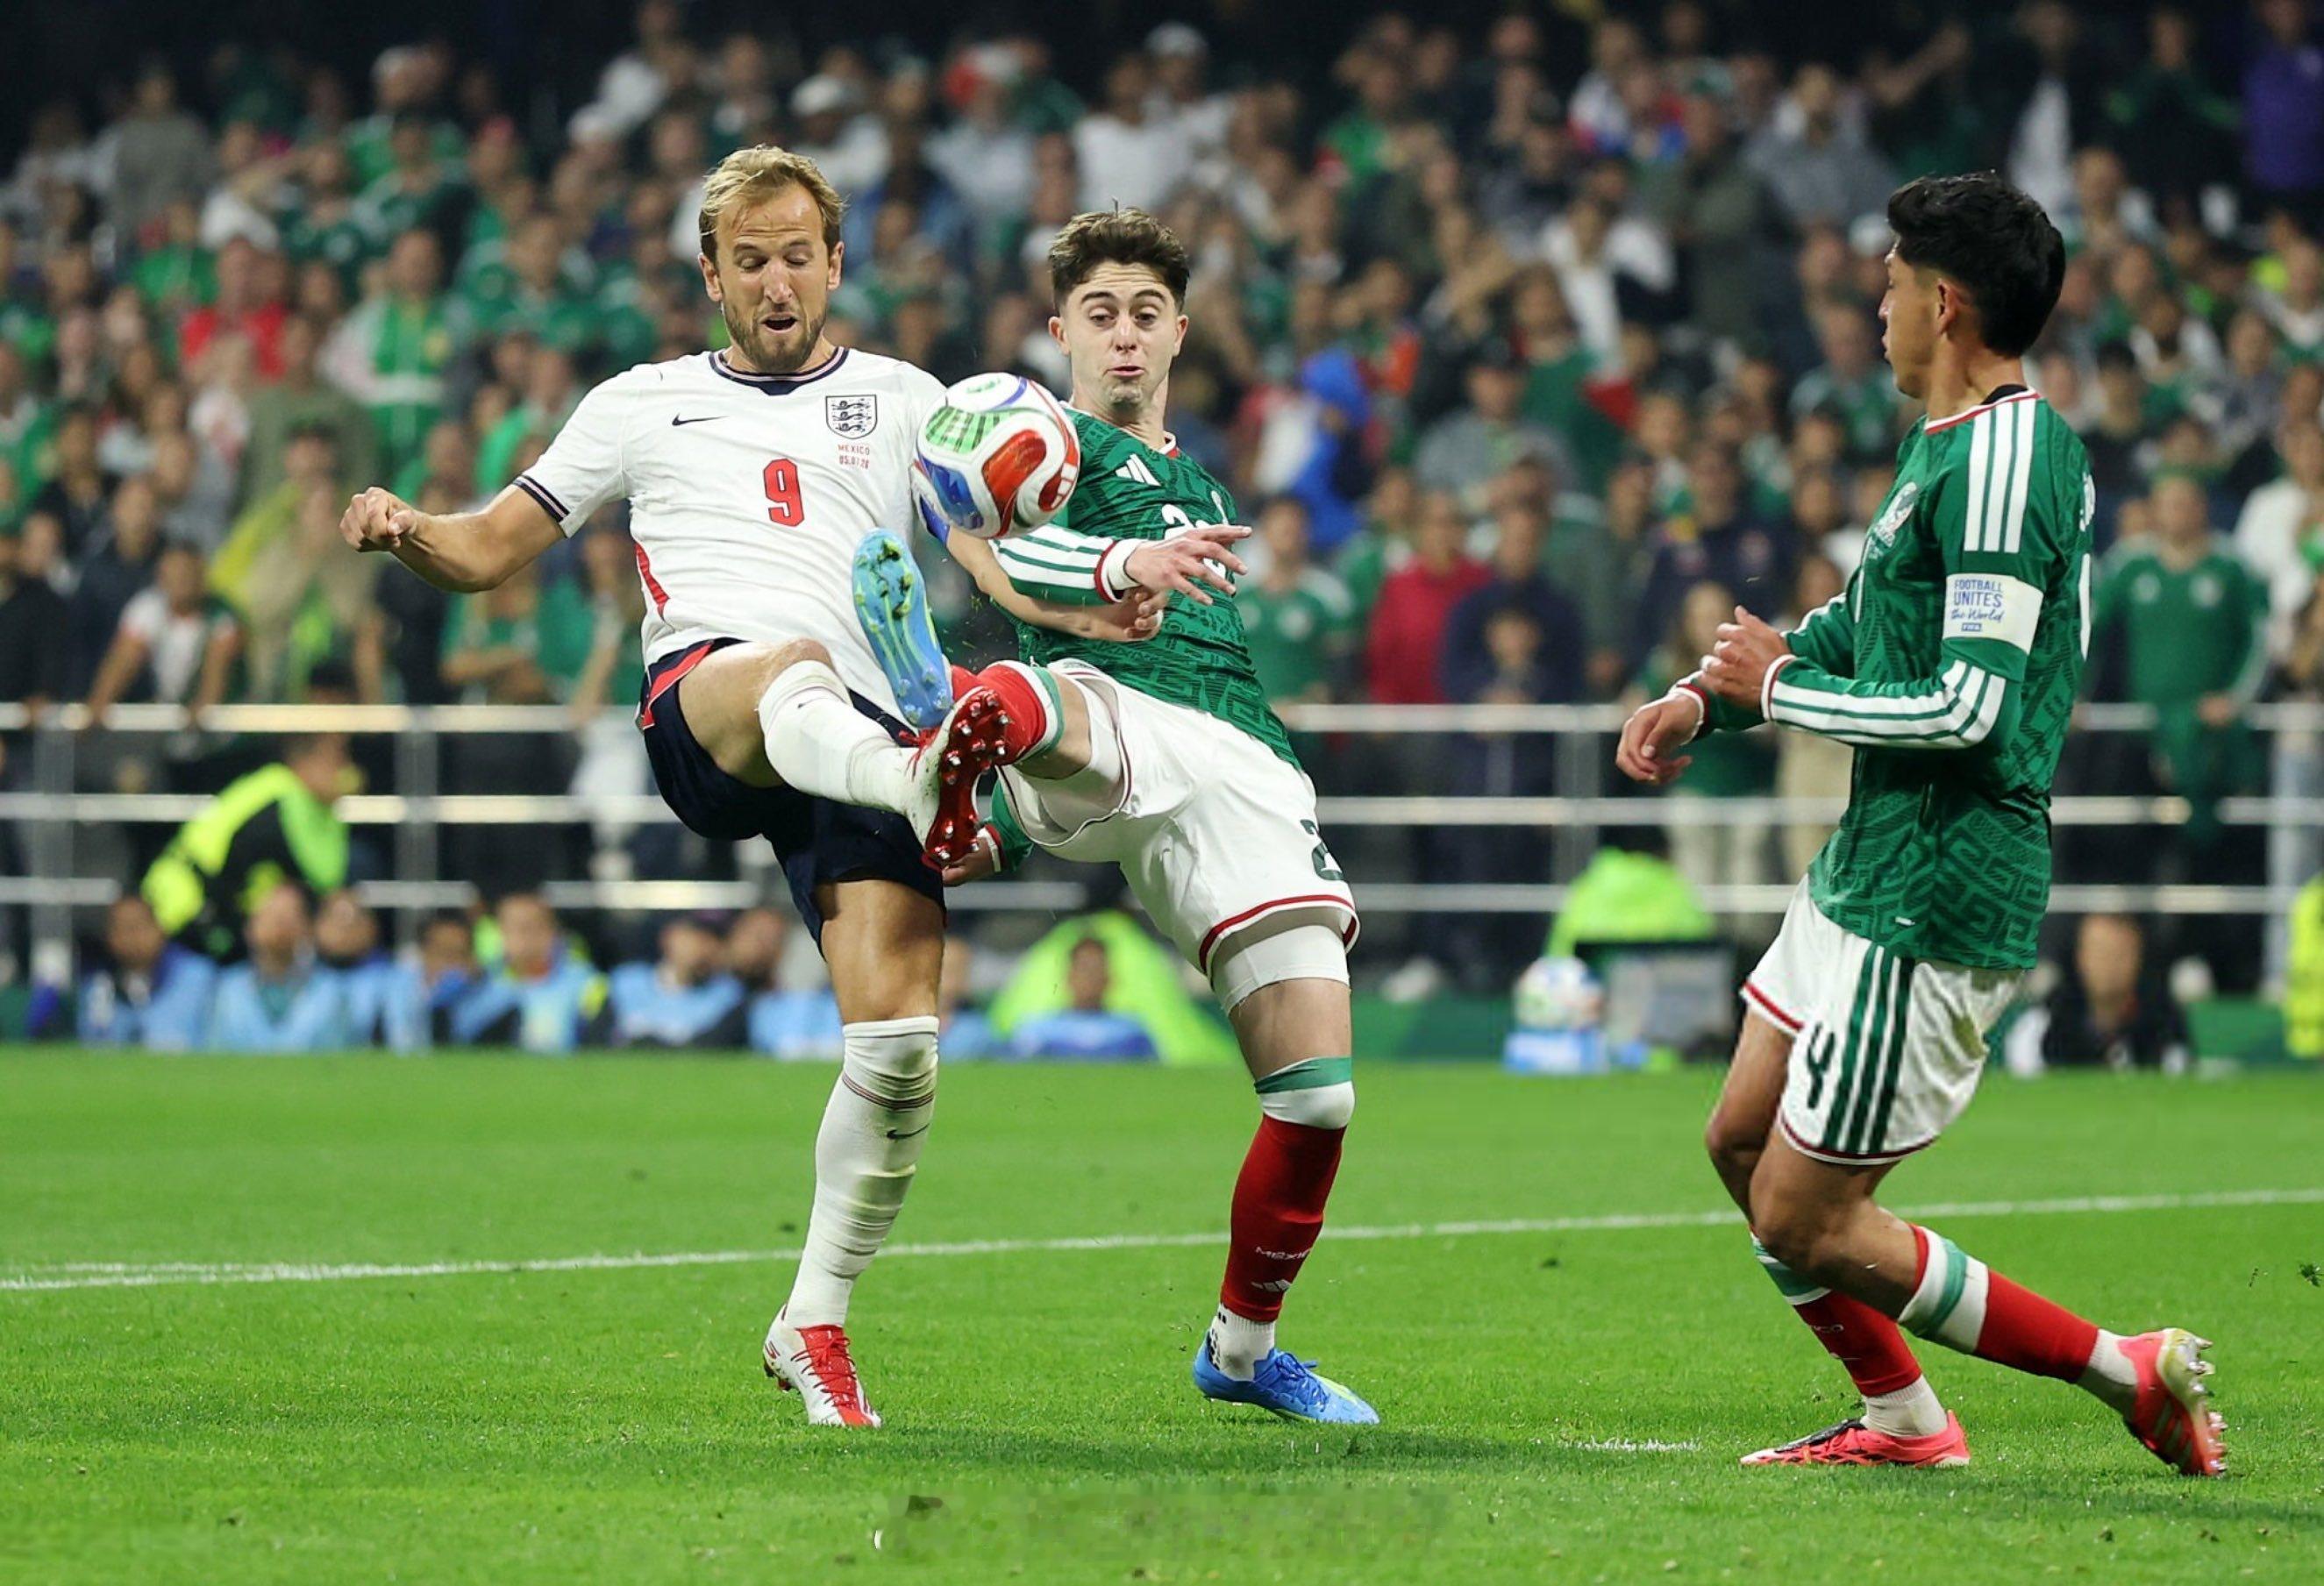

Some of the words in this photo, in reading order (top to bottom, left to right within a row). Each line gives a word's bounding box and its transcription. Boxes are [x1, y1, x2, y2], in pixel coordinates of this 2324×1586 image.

[838, 444, 870, 456] MEXICO
[764, 459, 804, 527] 9
[1954, 580, 2003, 592] FOOTBALL
[1953, 592, 2003, 608] UNITES
[1807, 1021, 1835, 1109] 4
